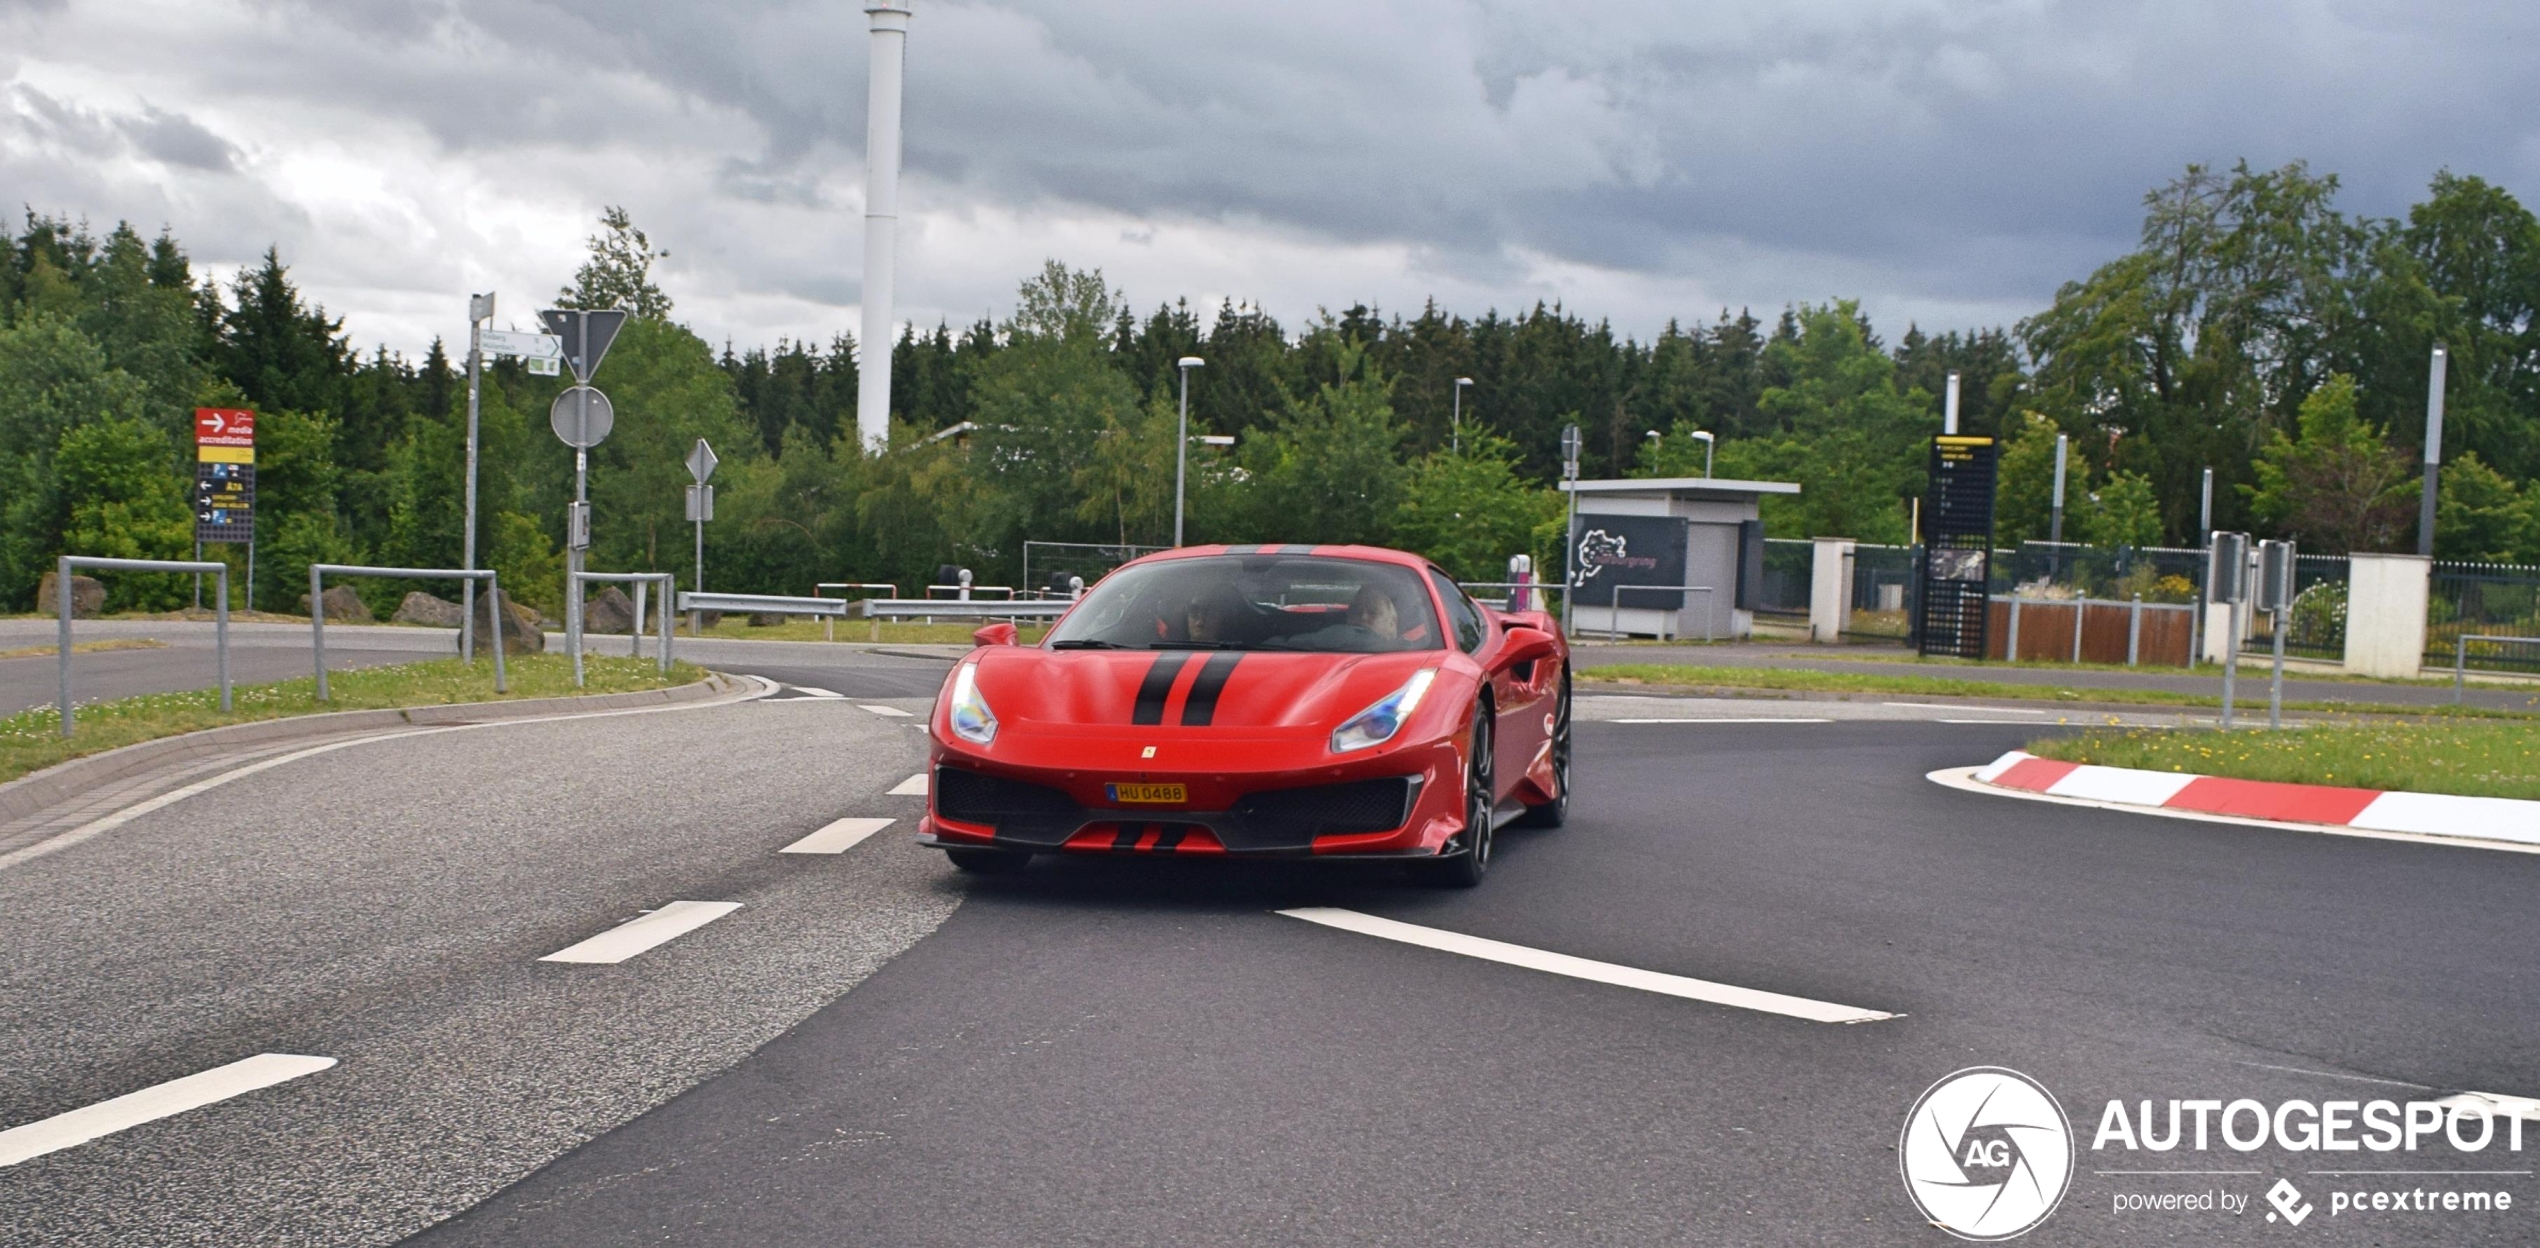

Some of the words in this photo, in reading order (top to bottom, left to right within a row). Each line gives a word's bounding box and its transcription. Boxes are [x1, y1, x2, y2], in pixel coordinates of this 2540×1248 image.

[227, 426, 253, 434] media
[198, 436, 253, 445] accreditation
[1120, 787, 1139, 799] HU
[1142, 787, 1182, 800] 0488
